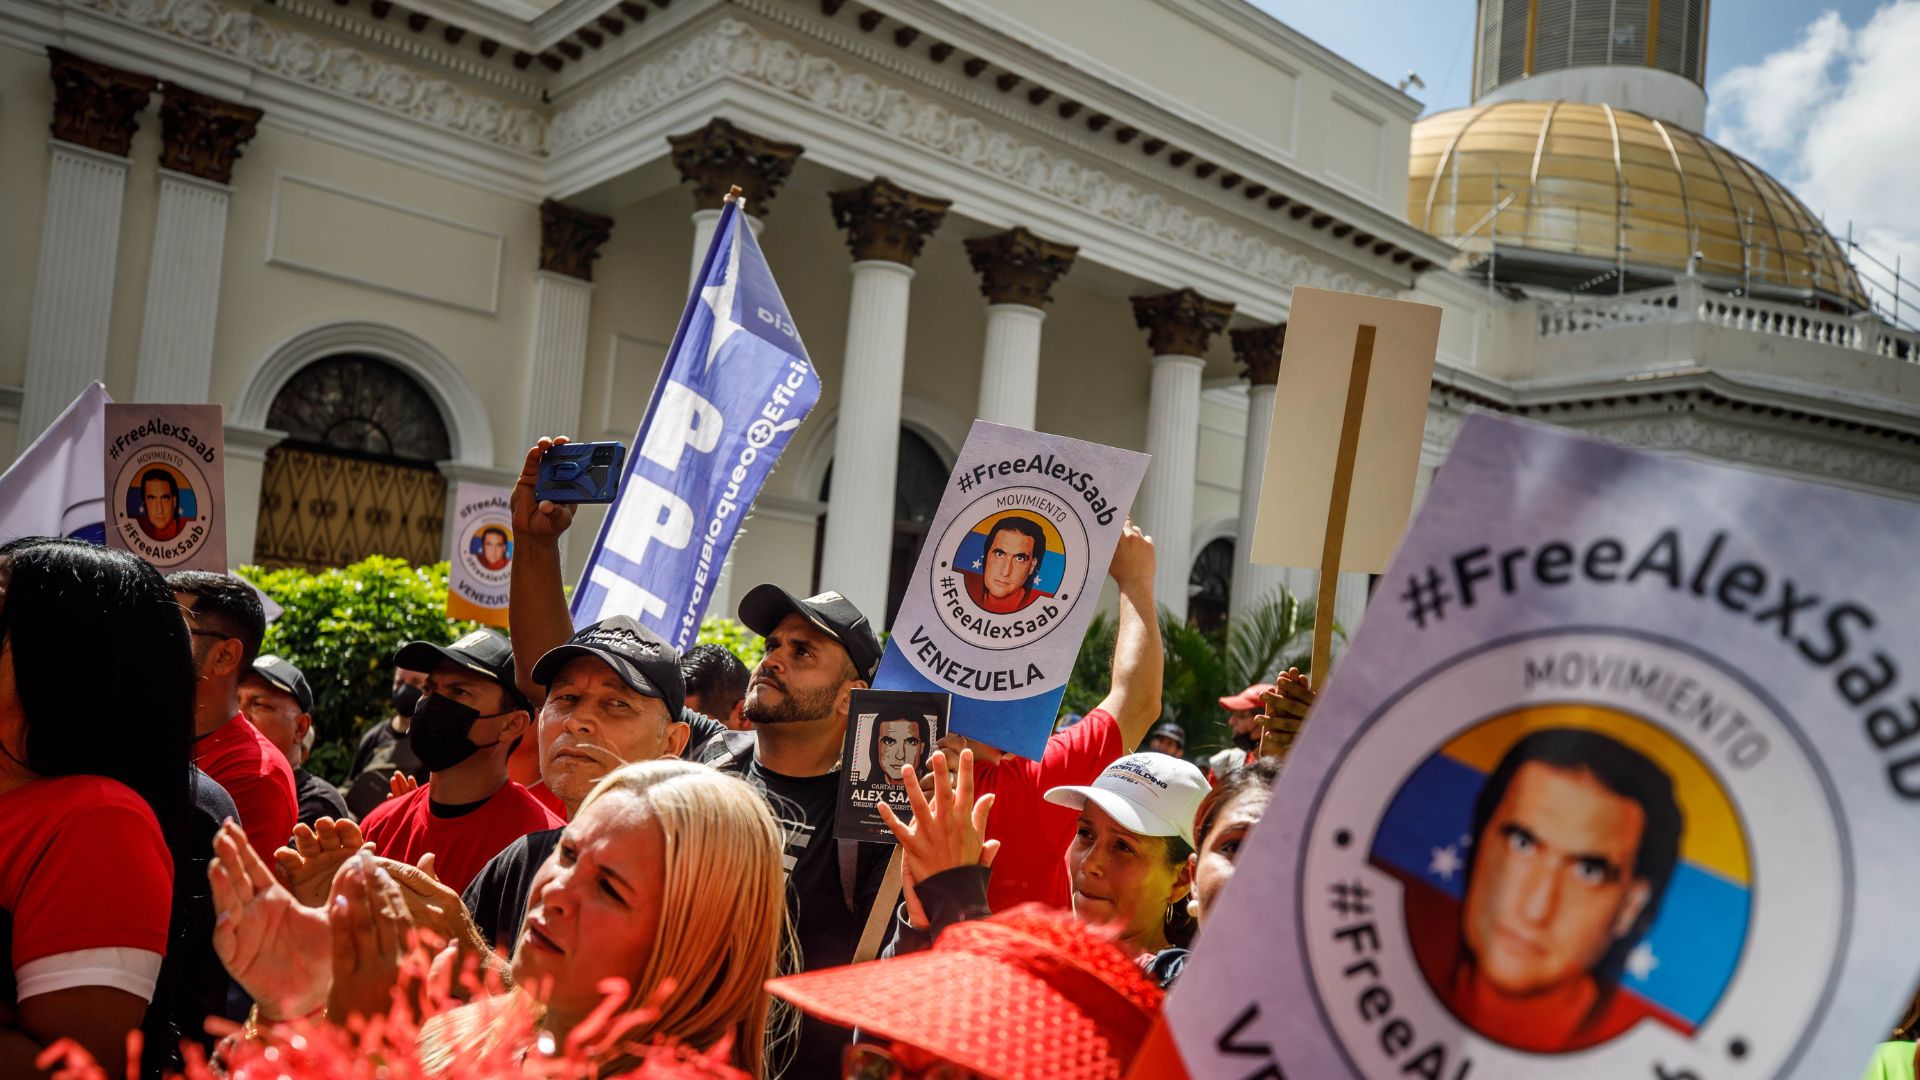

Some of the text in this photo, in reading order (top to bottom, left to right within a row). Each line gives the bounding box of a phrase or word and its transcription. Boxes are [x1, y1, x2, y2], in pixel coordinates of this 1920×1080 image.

[109, 418, 215, 464] #FreeAlexSaab
[136, 451, 183, 467] MOVIMIENTO
[460, 497, 511, 518] #FreeAle
[956, 454, 1119, 526] #FreeAlexSaab
[996, 494, 1067, 523] MOVIMIENTO
[124, 522, 204, 559] #FreeAlexSaab
[674, 447, 757, 657] ontraElBloqueo
[459, 580, 509, 605] VENEZUE
[940, 576, 1060, 639] #FreeAlexSaab
[909, 624, 1045, 692] VENEZUELA
[1523, 652, 1771, 774] MOVIMIENTO
[851, 789, 911, 803] ALEX SA
